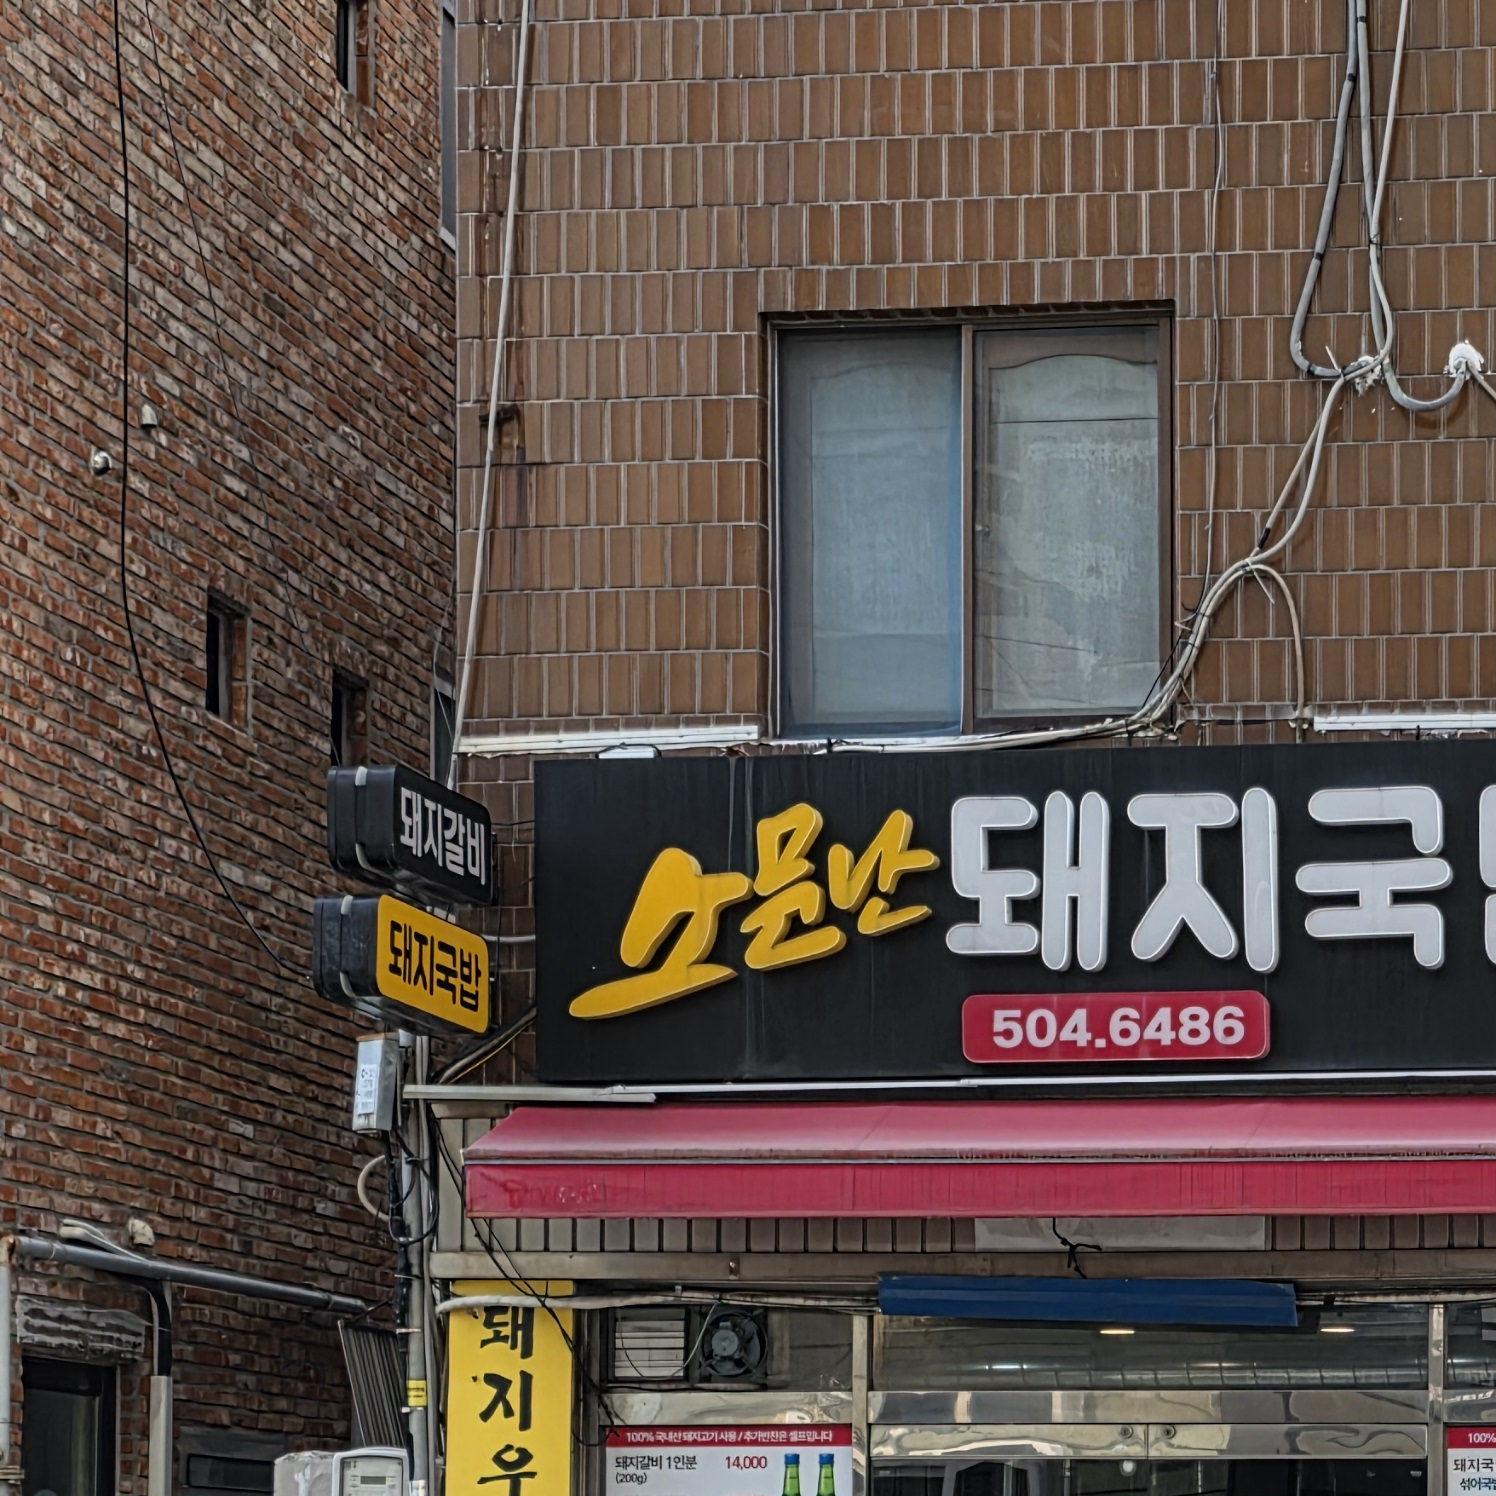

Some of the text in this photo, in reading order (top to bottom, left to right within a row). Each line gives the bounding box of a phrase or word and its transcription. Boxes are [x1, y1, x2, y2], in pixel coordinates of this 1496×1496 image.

[400, 786, 486, 886] 돼지갈비
[569, 803, 940, 1020] 소문난
[388, 919, 482, 1013] 돼지국밥
[992, 1004, 1246, 1049] 504.6486
[626, 1432, 654, 1443] 100%
[656, 1432, 682, 1443] 국내산
[683, 1432, 718, 1443] 돼지고기
[719, 1432, 736, 1443] 사용
[1468, 1432, 1496, 1443] 100%
[615, 1455, 697, 1470] 돼지갈비 1인분
[725, 1456, 768, 1470] 14,000
[615, 1472, 648, 1485] (200g)
